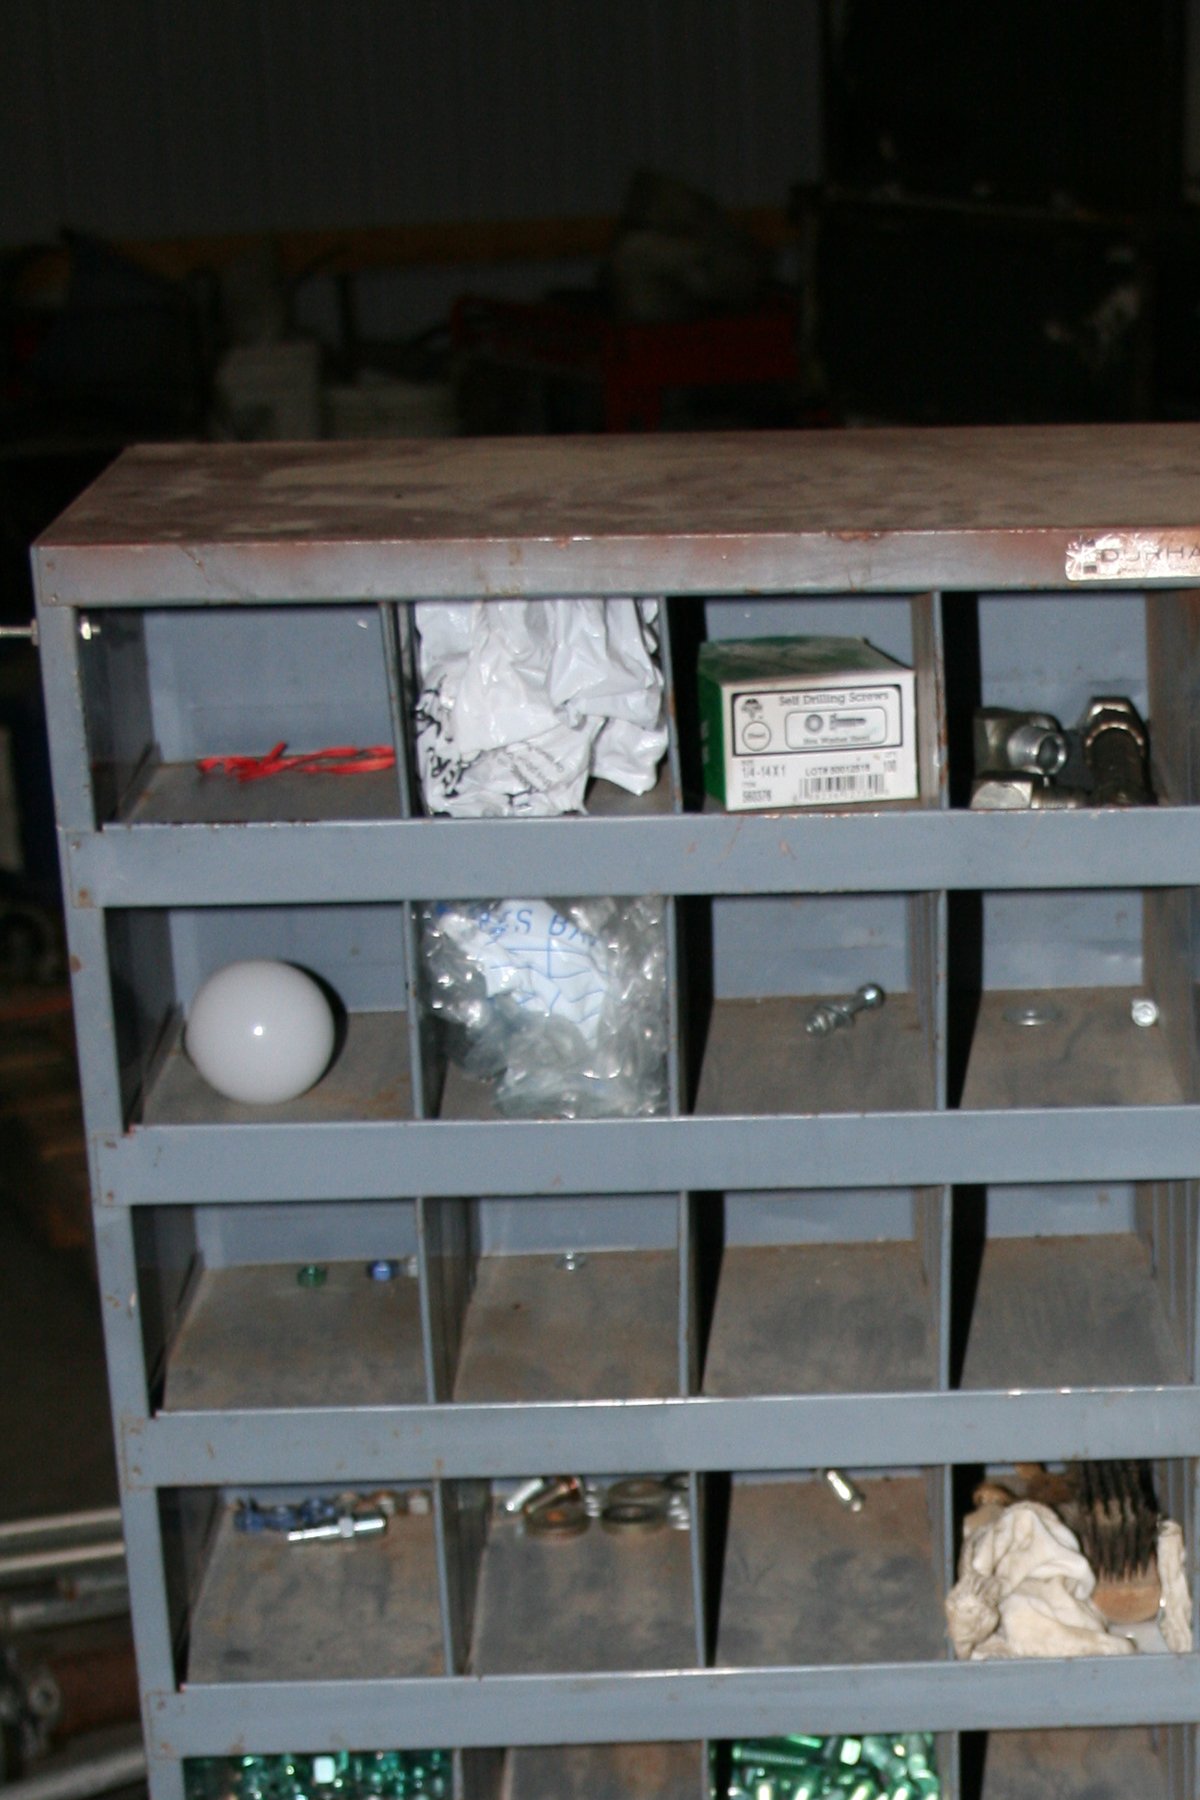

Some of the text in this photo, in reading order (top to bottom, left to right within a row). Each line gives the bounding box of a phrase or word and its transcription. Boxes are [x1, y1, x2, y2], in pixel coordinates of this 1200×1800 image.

[779, 691, 889, 706] Self Drilling Screws
